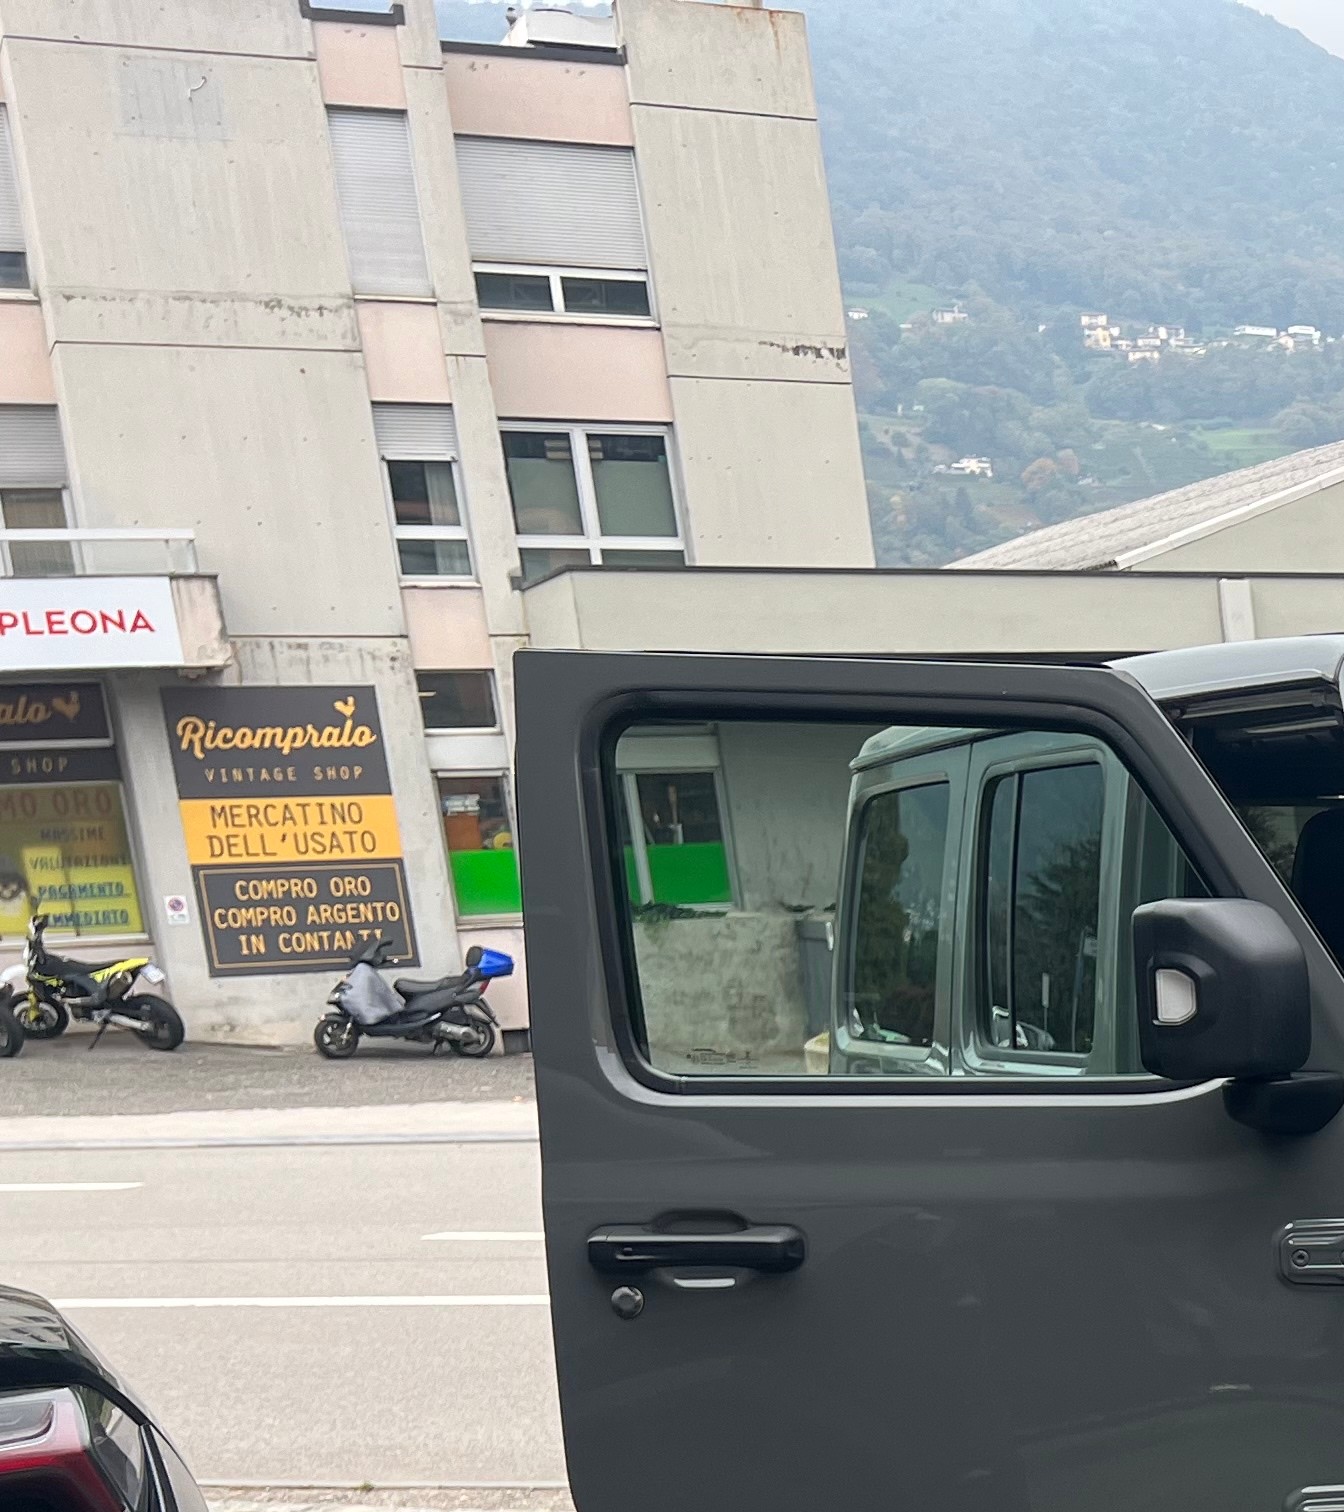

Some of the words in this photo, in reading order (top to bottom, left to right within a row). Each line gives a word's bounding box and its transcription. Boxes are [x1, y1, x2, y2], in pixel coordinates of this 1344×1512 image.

[0, 609, 157, 636] PLEONA
[176, 716, 378, 760] Ricompralo
[11, 756, 69, 776] SHOP
[205, 766, 297, 784] VINTAGE
[313, 765, 364, 781] SHOP
[210, 801, 364, 829] MERCATINO
[207, 830, 377, 858] DELL'USATO
[234, 876, 318, 900] COMPRO
[329, 875, 372, 897] ORO
[213, 904, 297, 929] COMPRO
[306, 901, 400, 926] ARGENTO
[239, 934, 266, 956] IN
